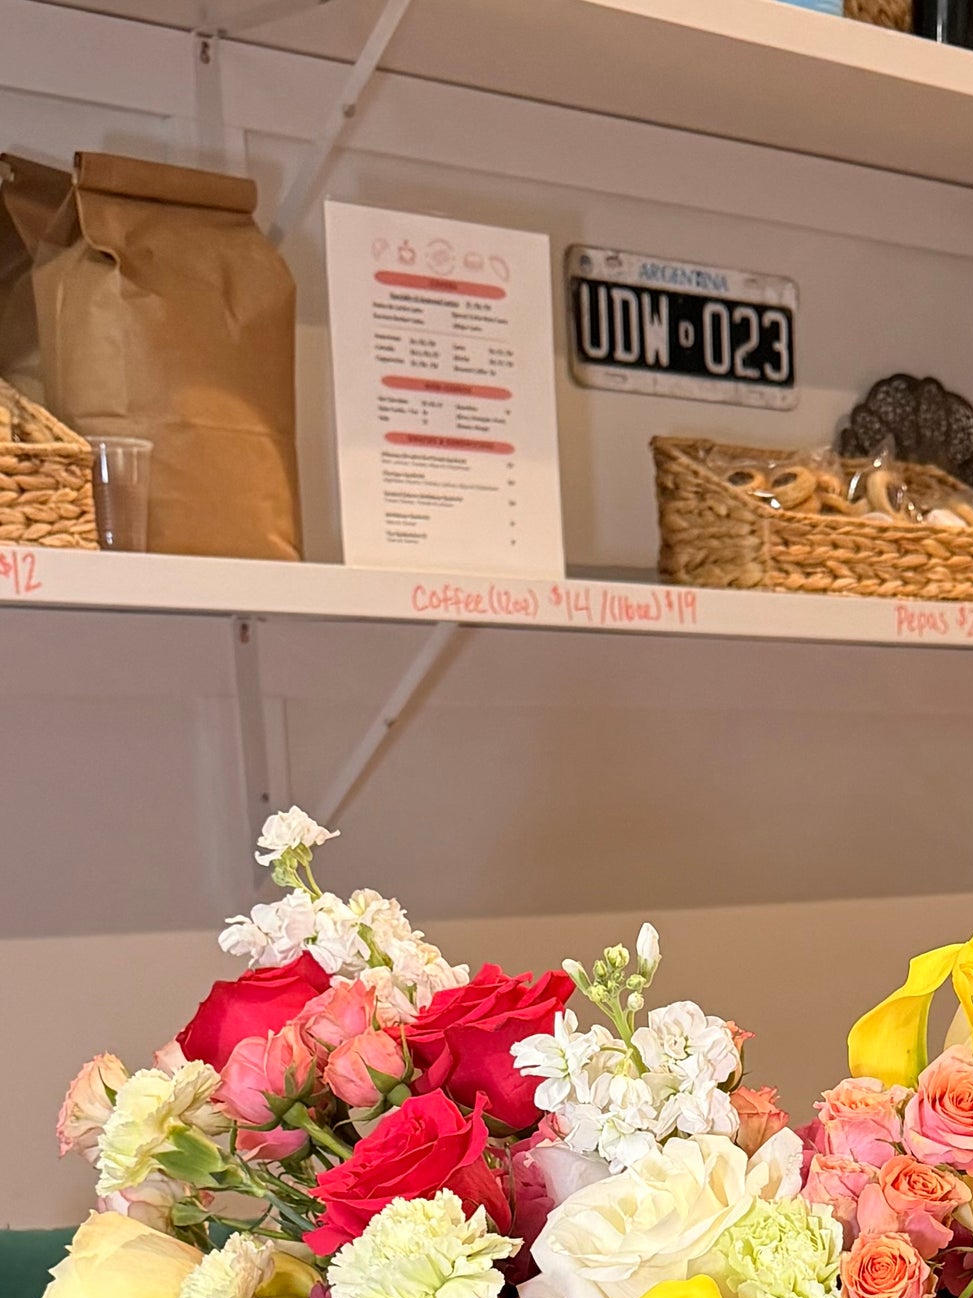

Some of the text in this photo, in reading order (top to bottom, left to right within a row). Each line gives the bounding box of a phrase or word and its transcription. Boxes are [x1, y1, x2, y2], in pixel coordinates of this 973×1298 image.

[639, 262, 729, 293] ARGENTINA
[579, 283, 670, 369] UDW
[703, 302, 789, 382] 023
[549, 584, 593, 622] $14
[894, 604, 949, 637] Pepas
